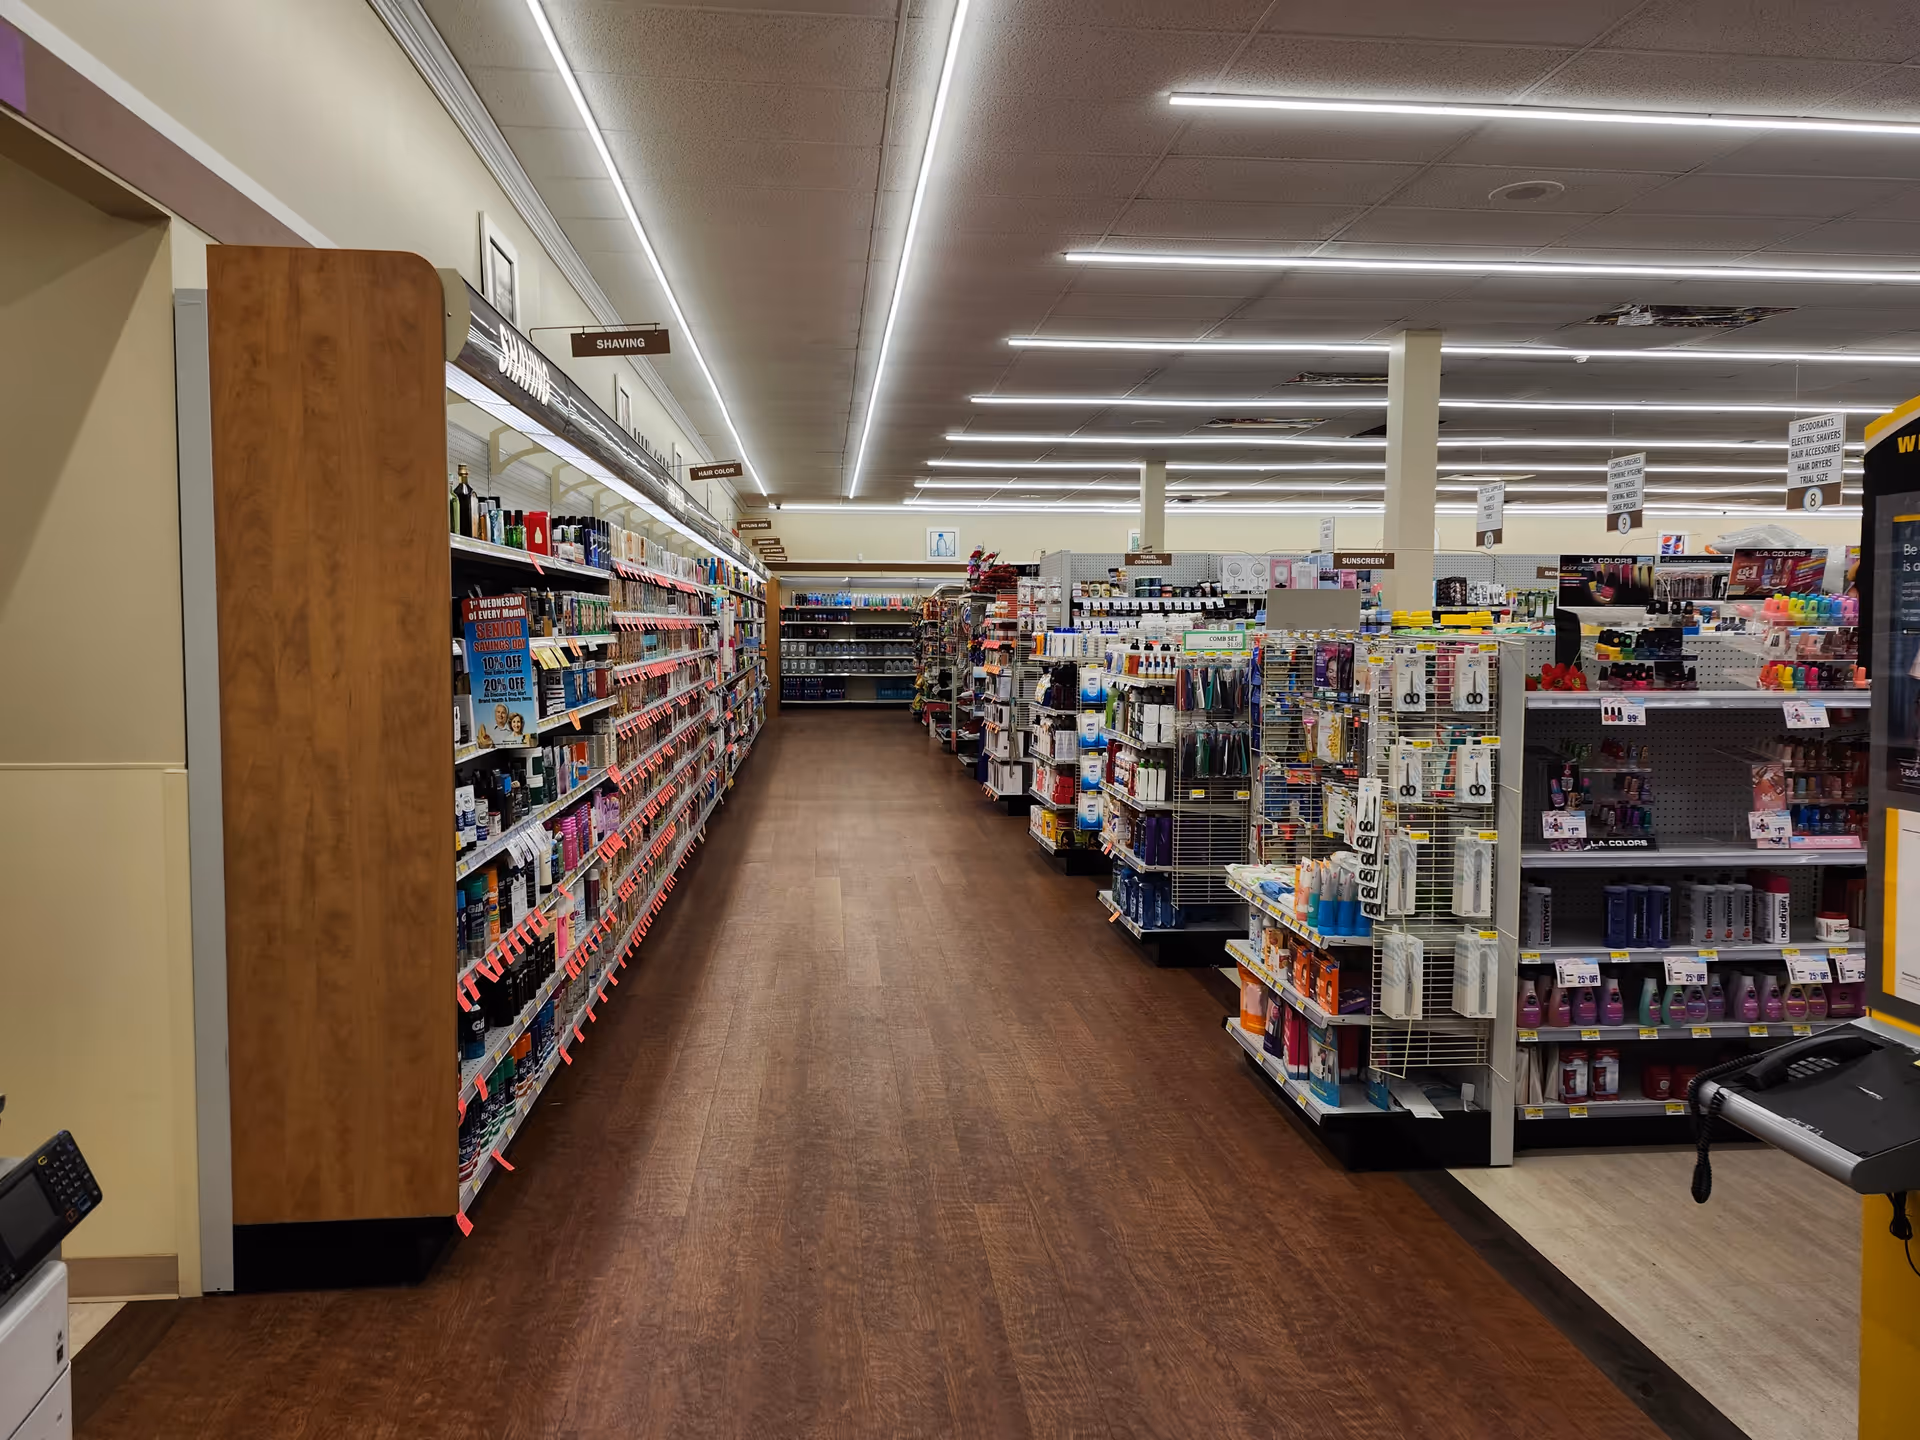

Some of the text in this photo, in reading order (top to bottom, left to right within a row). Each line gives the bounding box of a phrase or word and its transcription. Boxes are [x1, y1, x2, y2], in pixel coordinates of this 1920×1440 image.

[596, 338, 646, 349] SHAVING
[499, 323, 550, 407] SHAVING
[1798, 418, 1834, 432] DEODORANTS
[1791, 430, 1841, 446] ELECTRIC SHAVERS
[1791, 444, 1840, 459] HAIR ACCESSORIES
[714, 467, 735, 475] COLOR
[1797, 459, 1832, 471] HAIR DRYERS
[1610, 467, 1643, 479] FEMININE HYGIENE
[1800, 473, 1829, 484] TRIAL SIZE
[1612, 490, 1638, 501] SEWING NEEDS
[1810, 493, 1816, 507] 8
[1613, 502, 1636, 511] SHOE POLISH
[1622, 517, 1627, 529] 9
[1904, 544, 1918, 556] Be
[1341, 557, 1385, 565] SUNSCREEN
[1903, 560, 1911, 571] is
[1736, 565, 1759, 582] gel
[479, 597, 523, 608] WEDNESDAY
[468, 608, 525, 620] of EVERY Month
[475, 620, 522, 639] SENIOR
[473, 638, 527, 652] SAVINGS DAY
[482, 654, 522, 670] 10% OFF
[483, 676, 525, 692] 20% OFF
[1779, 899, 1788, 938] nail dryer
[1589, 975, 1598, 983] OFF
[1696, 973, 1705, 981] OFF
[1820, 972, 1829, 980] OFF
